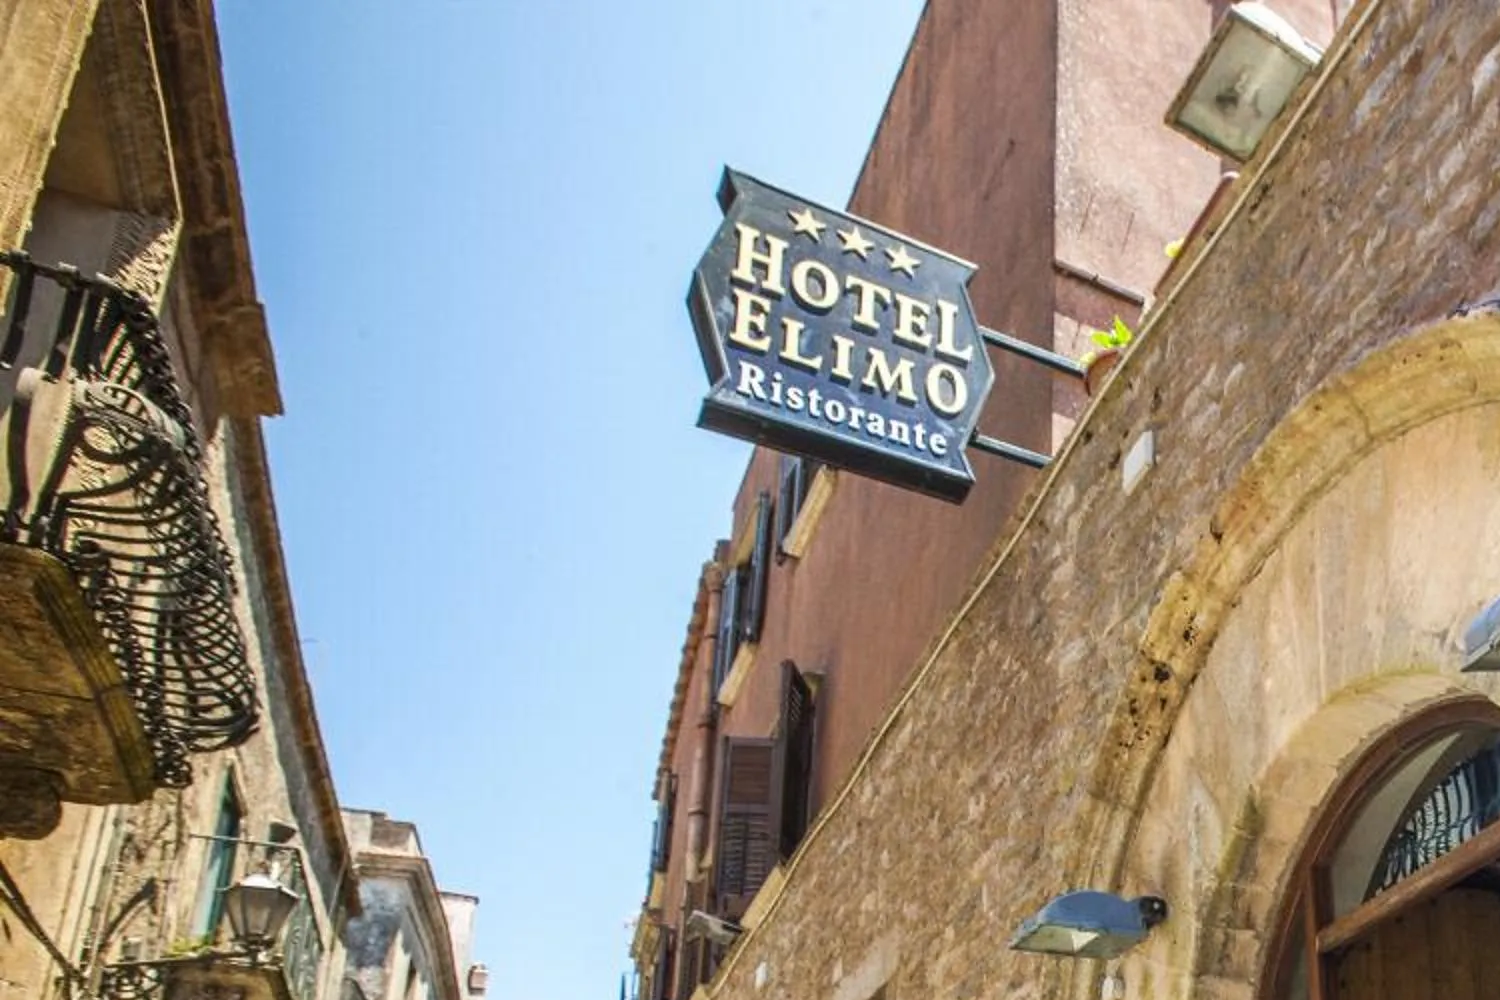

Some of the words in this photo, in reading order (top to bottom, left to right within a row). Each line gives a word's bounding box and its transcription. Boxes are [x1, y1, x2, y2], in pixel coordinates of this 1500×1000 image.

[728, 287, 969, 418] ELIMO
[731, 222, 973, 364] HOTEL
[736, 359, 949, 456] Ristorante
